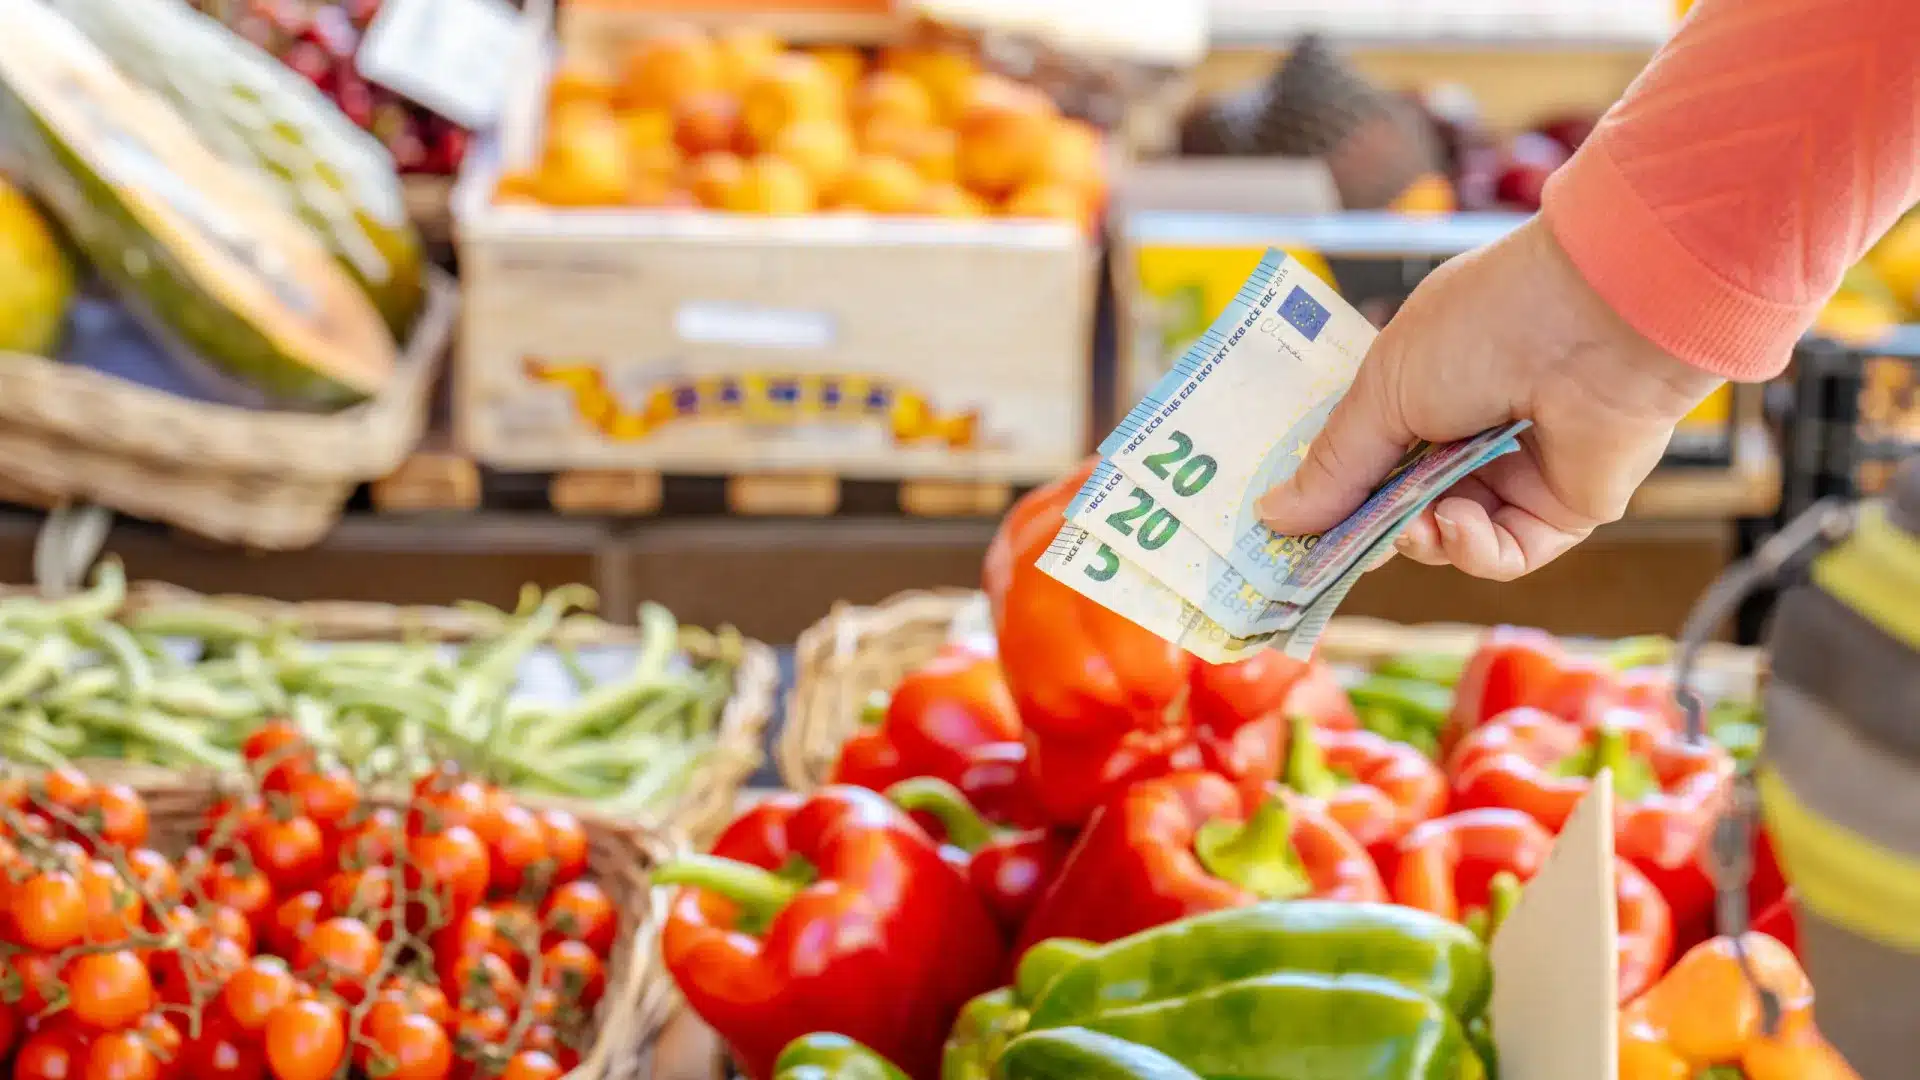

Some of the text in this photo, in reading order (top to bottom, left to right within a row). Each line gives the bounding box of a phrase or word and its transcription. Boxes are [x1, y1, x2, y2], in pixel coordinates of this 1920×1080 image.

[1145, 416, 1163, 434] ECB
[1180, 382, 1197, 399] EZB
[1195, 363, 1212, 382] EKP
[1228, 327, 1246, 346] EKB
[1259, 288, 1277, 308] EBC
[1274, 268, 1289, 287] 2015
[1105, 473, 1123, 491] ECB
[1142, 430, 1218, 497] 20
[1105, 487, 1181, 551] 20
[1083, 543, 1120, 582] 5
